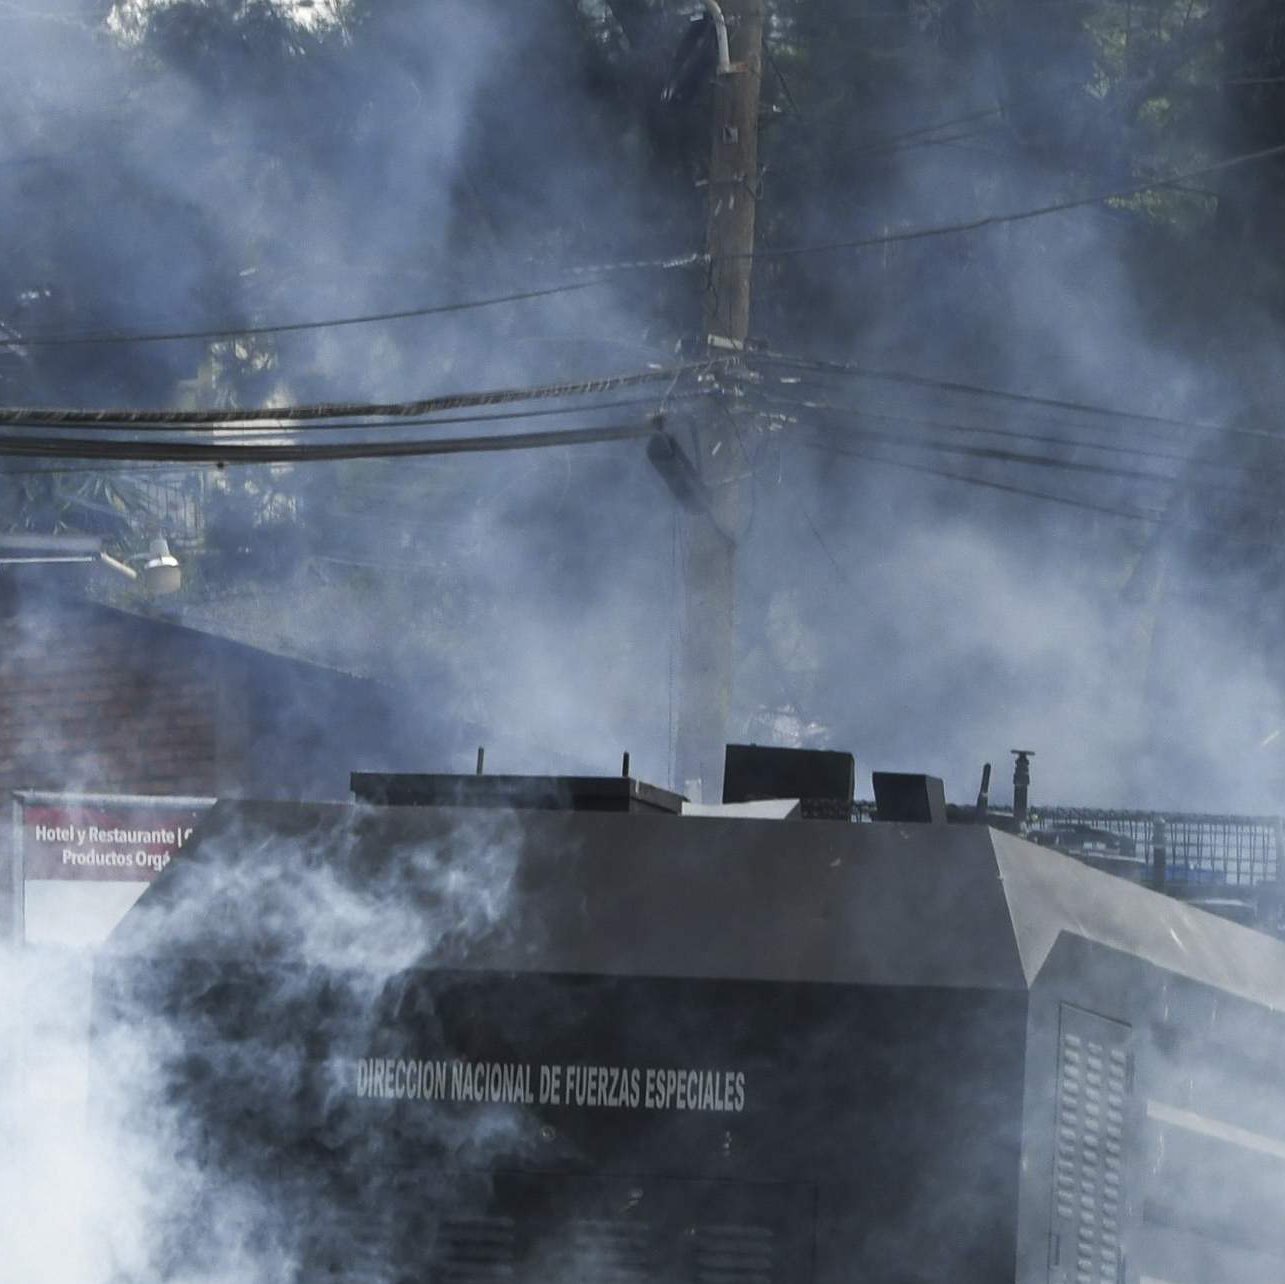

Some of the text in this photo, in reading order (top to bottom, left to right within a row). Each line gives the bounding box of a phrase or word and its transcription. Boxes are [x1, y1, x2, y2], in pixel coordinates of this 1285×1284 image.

[35, 825, 73, 842] Hotel
[77, 829, 86, 846] y
[88, 826, 175, 843] Restaurante
[62, 849, 171, 872] Productos Orgá
[357, 1058, 745, 1112] DIRECCION NACIONAL DE FUERZAS ESPECIALES
